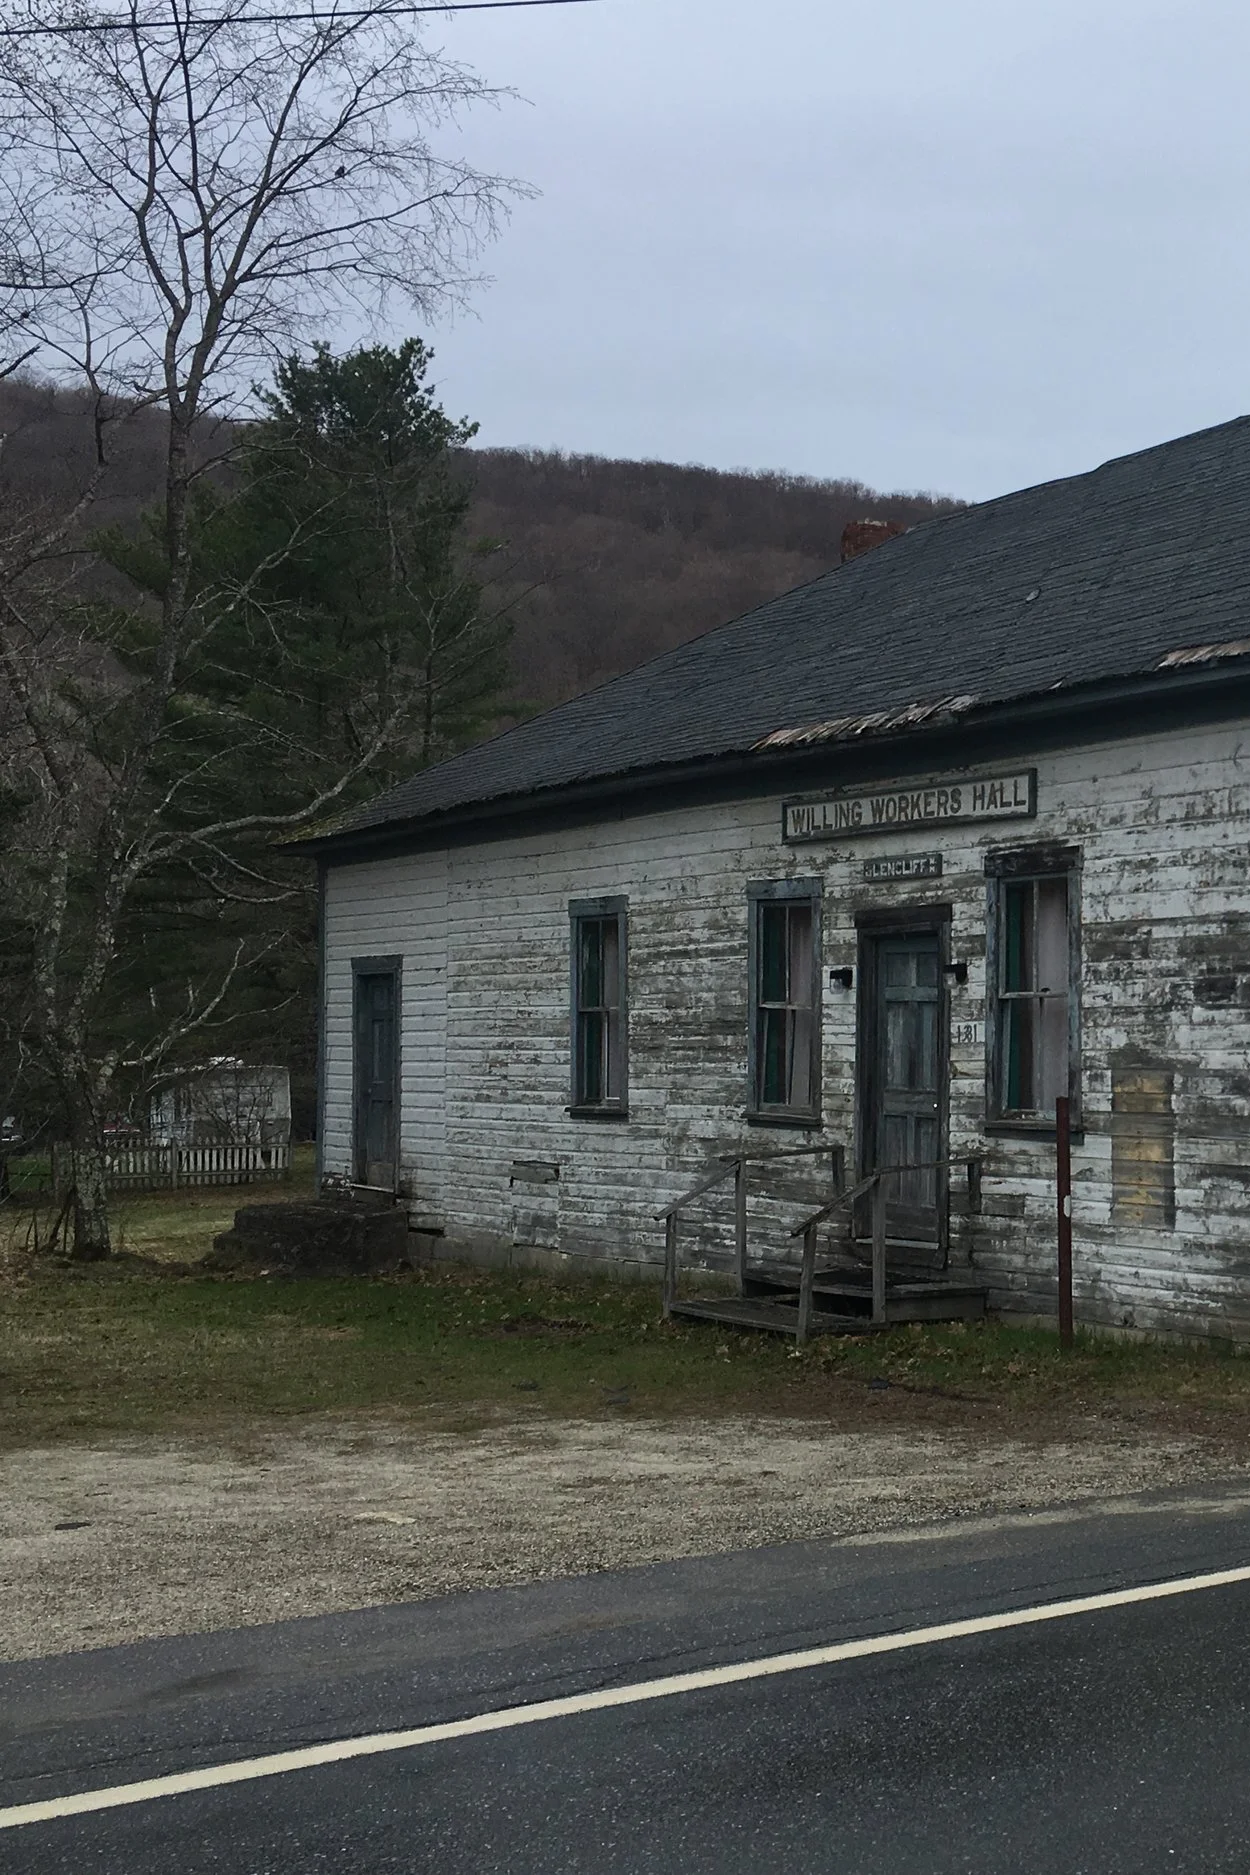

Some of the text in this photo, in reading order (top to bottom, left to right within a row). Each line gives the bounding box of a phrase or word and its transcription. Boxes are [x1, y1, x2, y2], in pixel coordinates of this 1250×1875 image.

[791, 779, 1027, 833] WILLING WORKERS HALL
